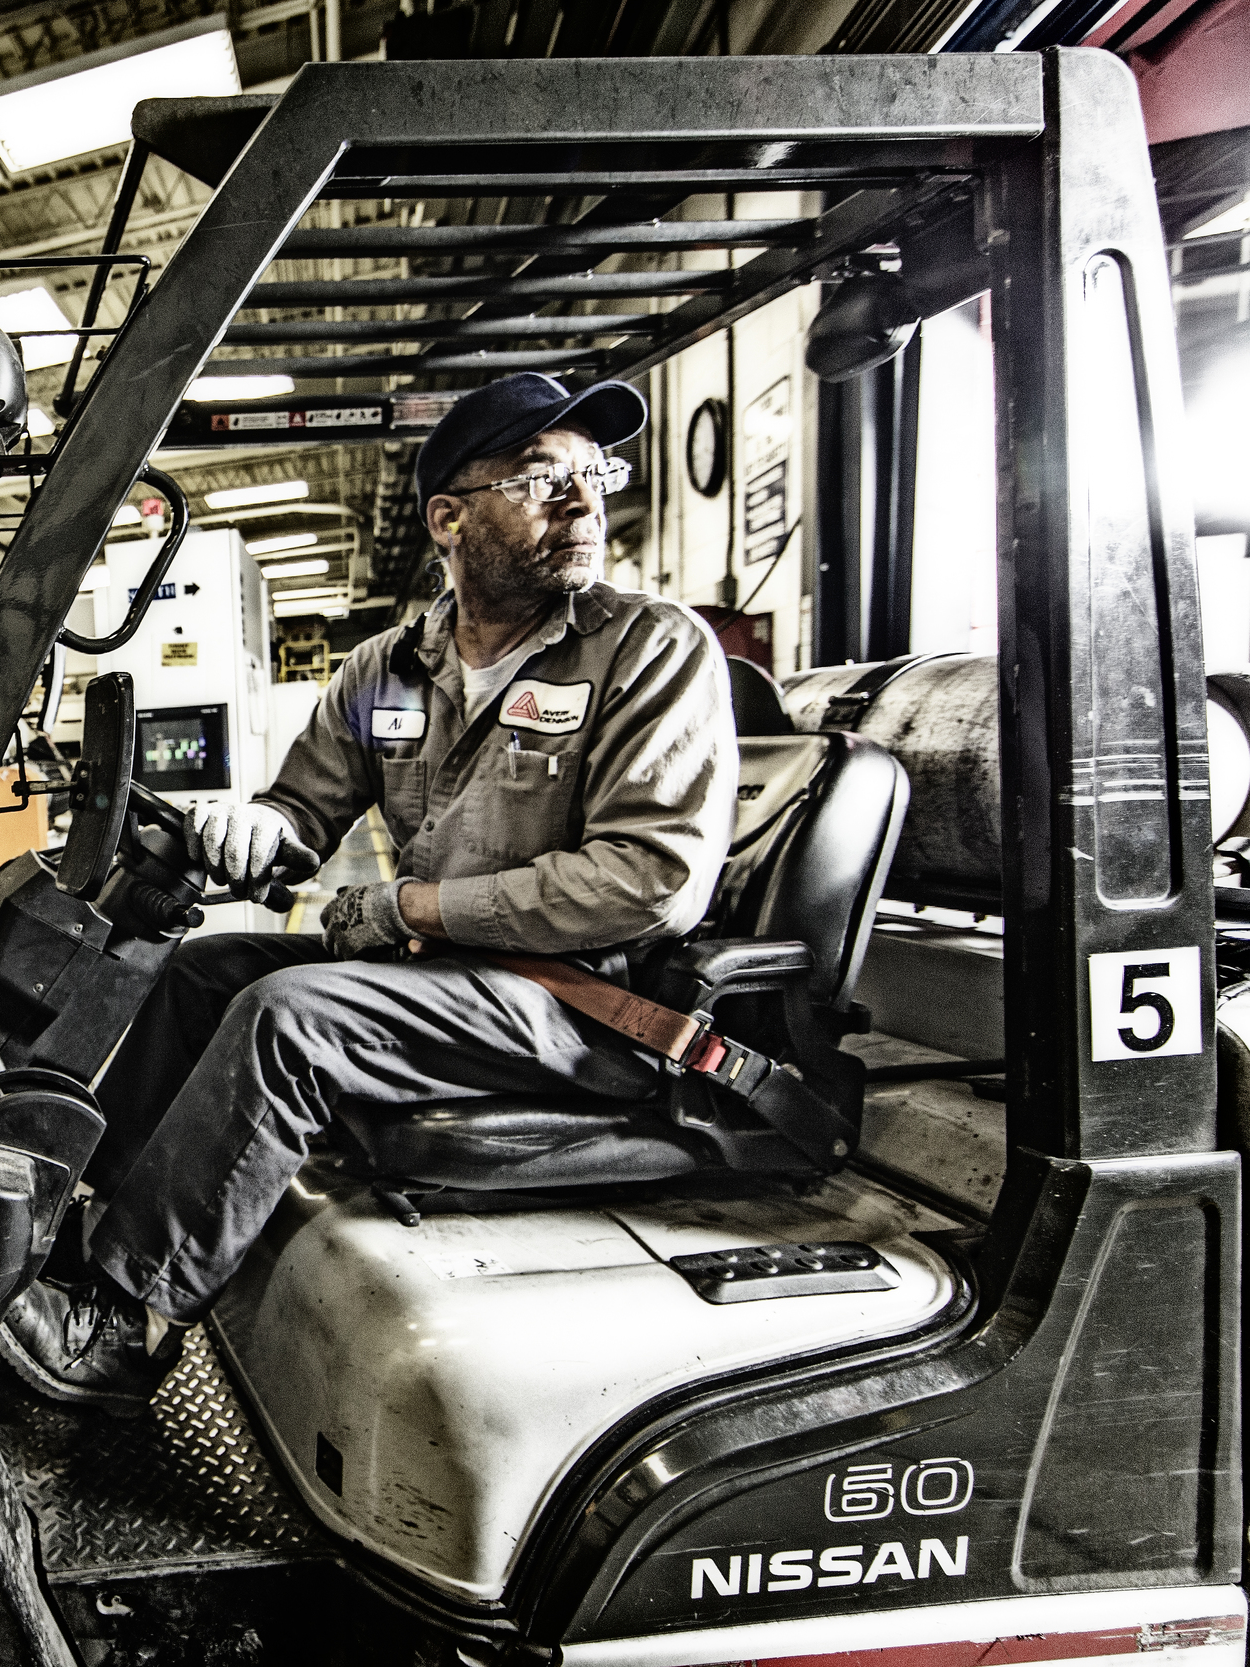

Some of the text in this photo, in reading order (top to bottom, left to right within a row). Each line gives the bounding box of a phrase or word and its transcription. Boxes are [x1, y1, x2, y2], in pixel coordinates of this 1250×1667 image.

[1117, 962, 1175, 1053] 5
[824, 1457, 974, 1522] 60
[691, 1536, 969, 1599] NISSAN
